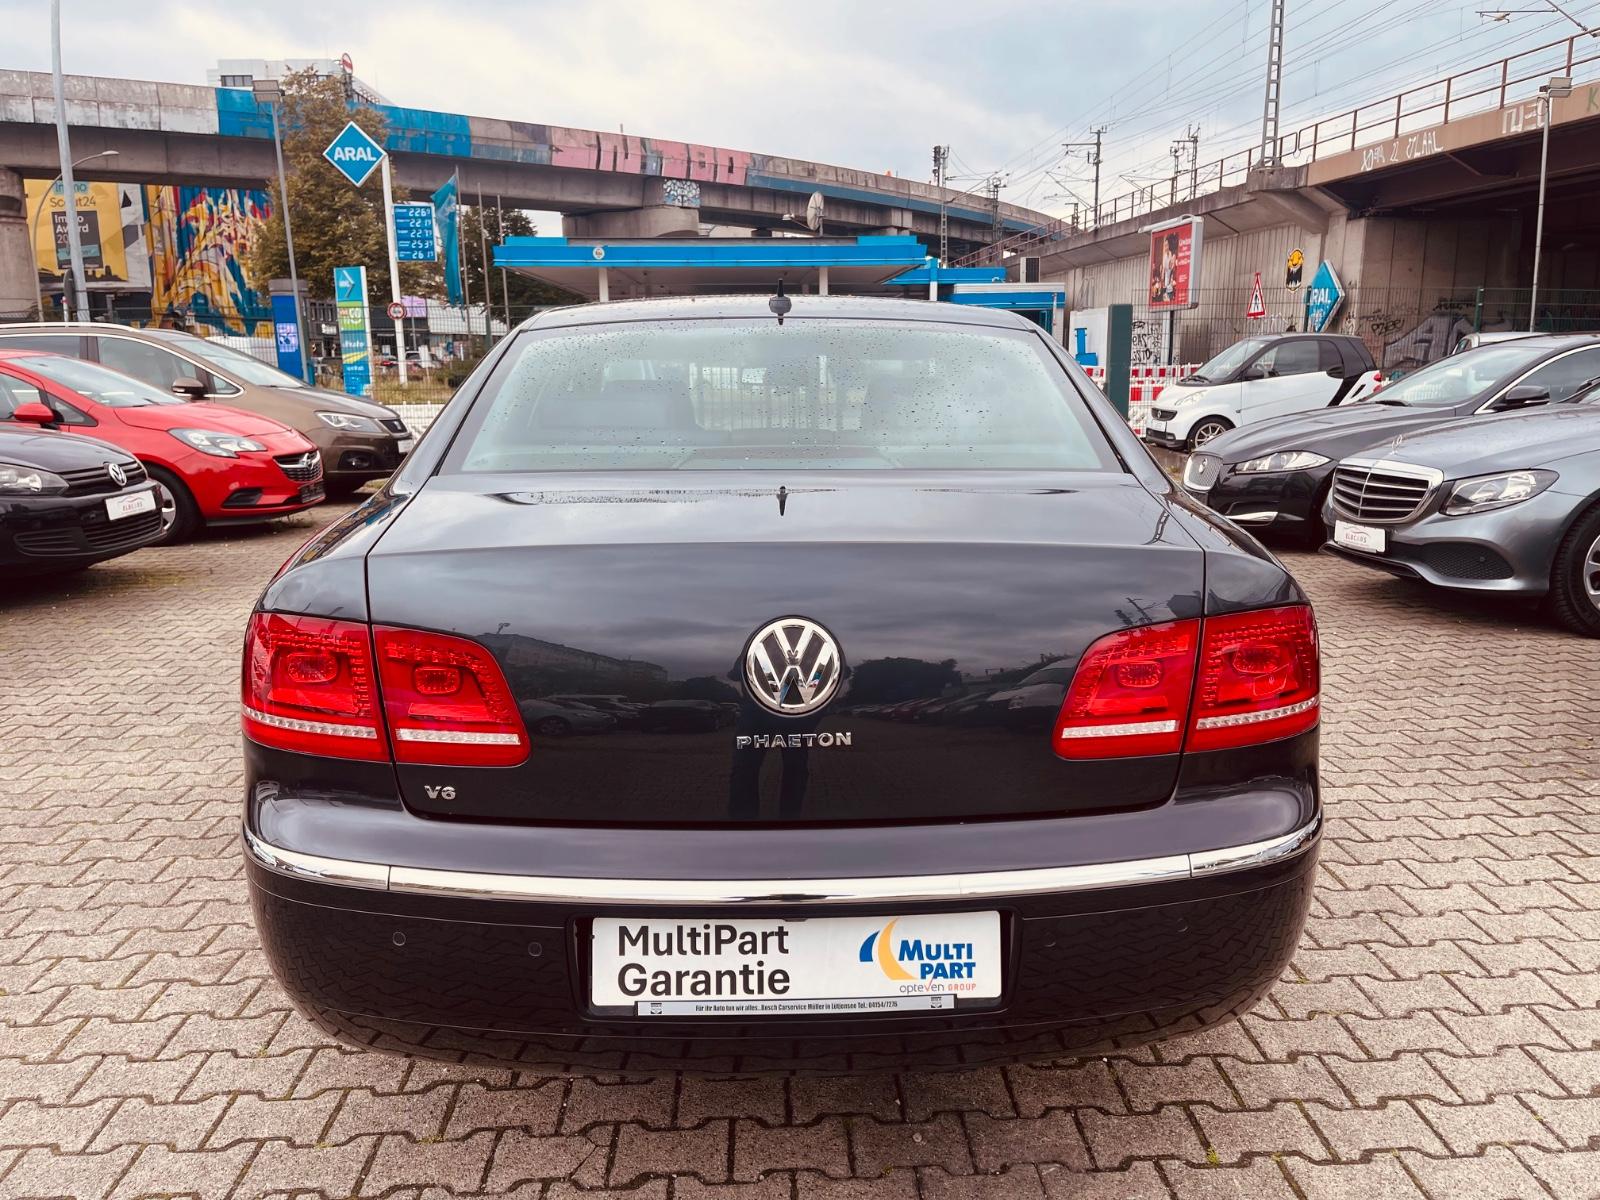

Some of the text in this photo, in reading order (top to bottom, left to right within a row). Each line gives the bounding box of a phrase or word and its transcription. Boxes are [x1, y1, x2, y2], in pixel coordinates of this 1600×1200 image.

[334, 146, 376, 161] ARAL
[50, 196, 96, 207] Sct24
[54, 214, 84, 223] Imo
[1309, 288, 1331, 305] RAL
[736, 732, 852, 749] PHAETON
[424, 785, 456, 800] V6
[618, 924, 789, 956] MultiPart
[898, 939, 973, 961] MULTI
[617, 961, 790, 997] Garantie
[920, 962, 976, 979] PART
[899, 979, 976, 994] opteven GROUP
